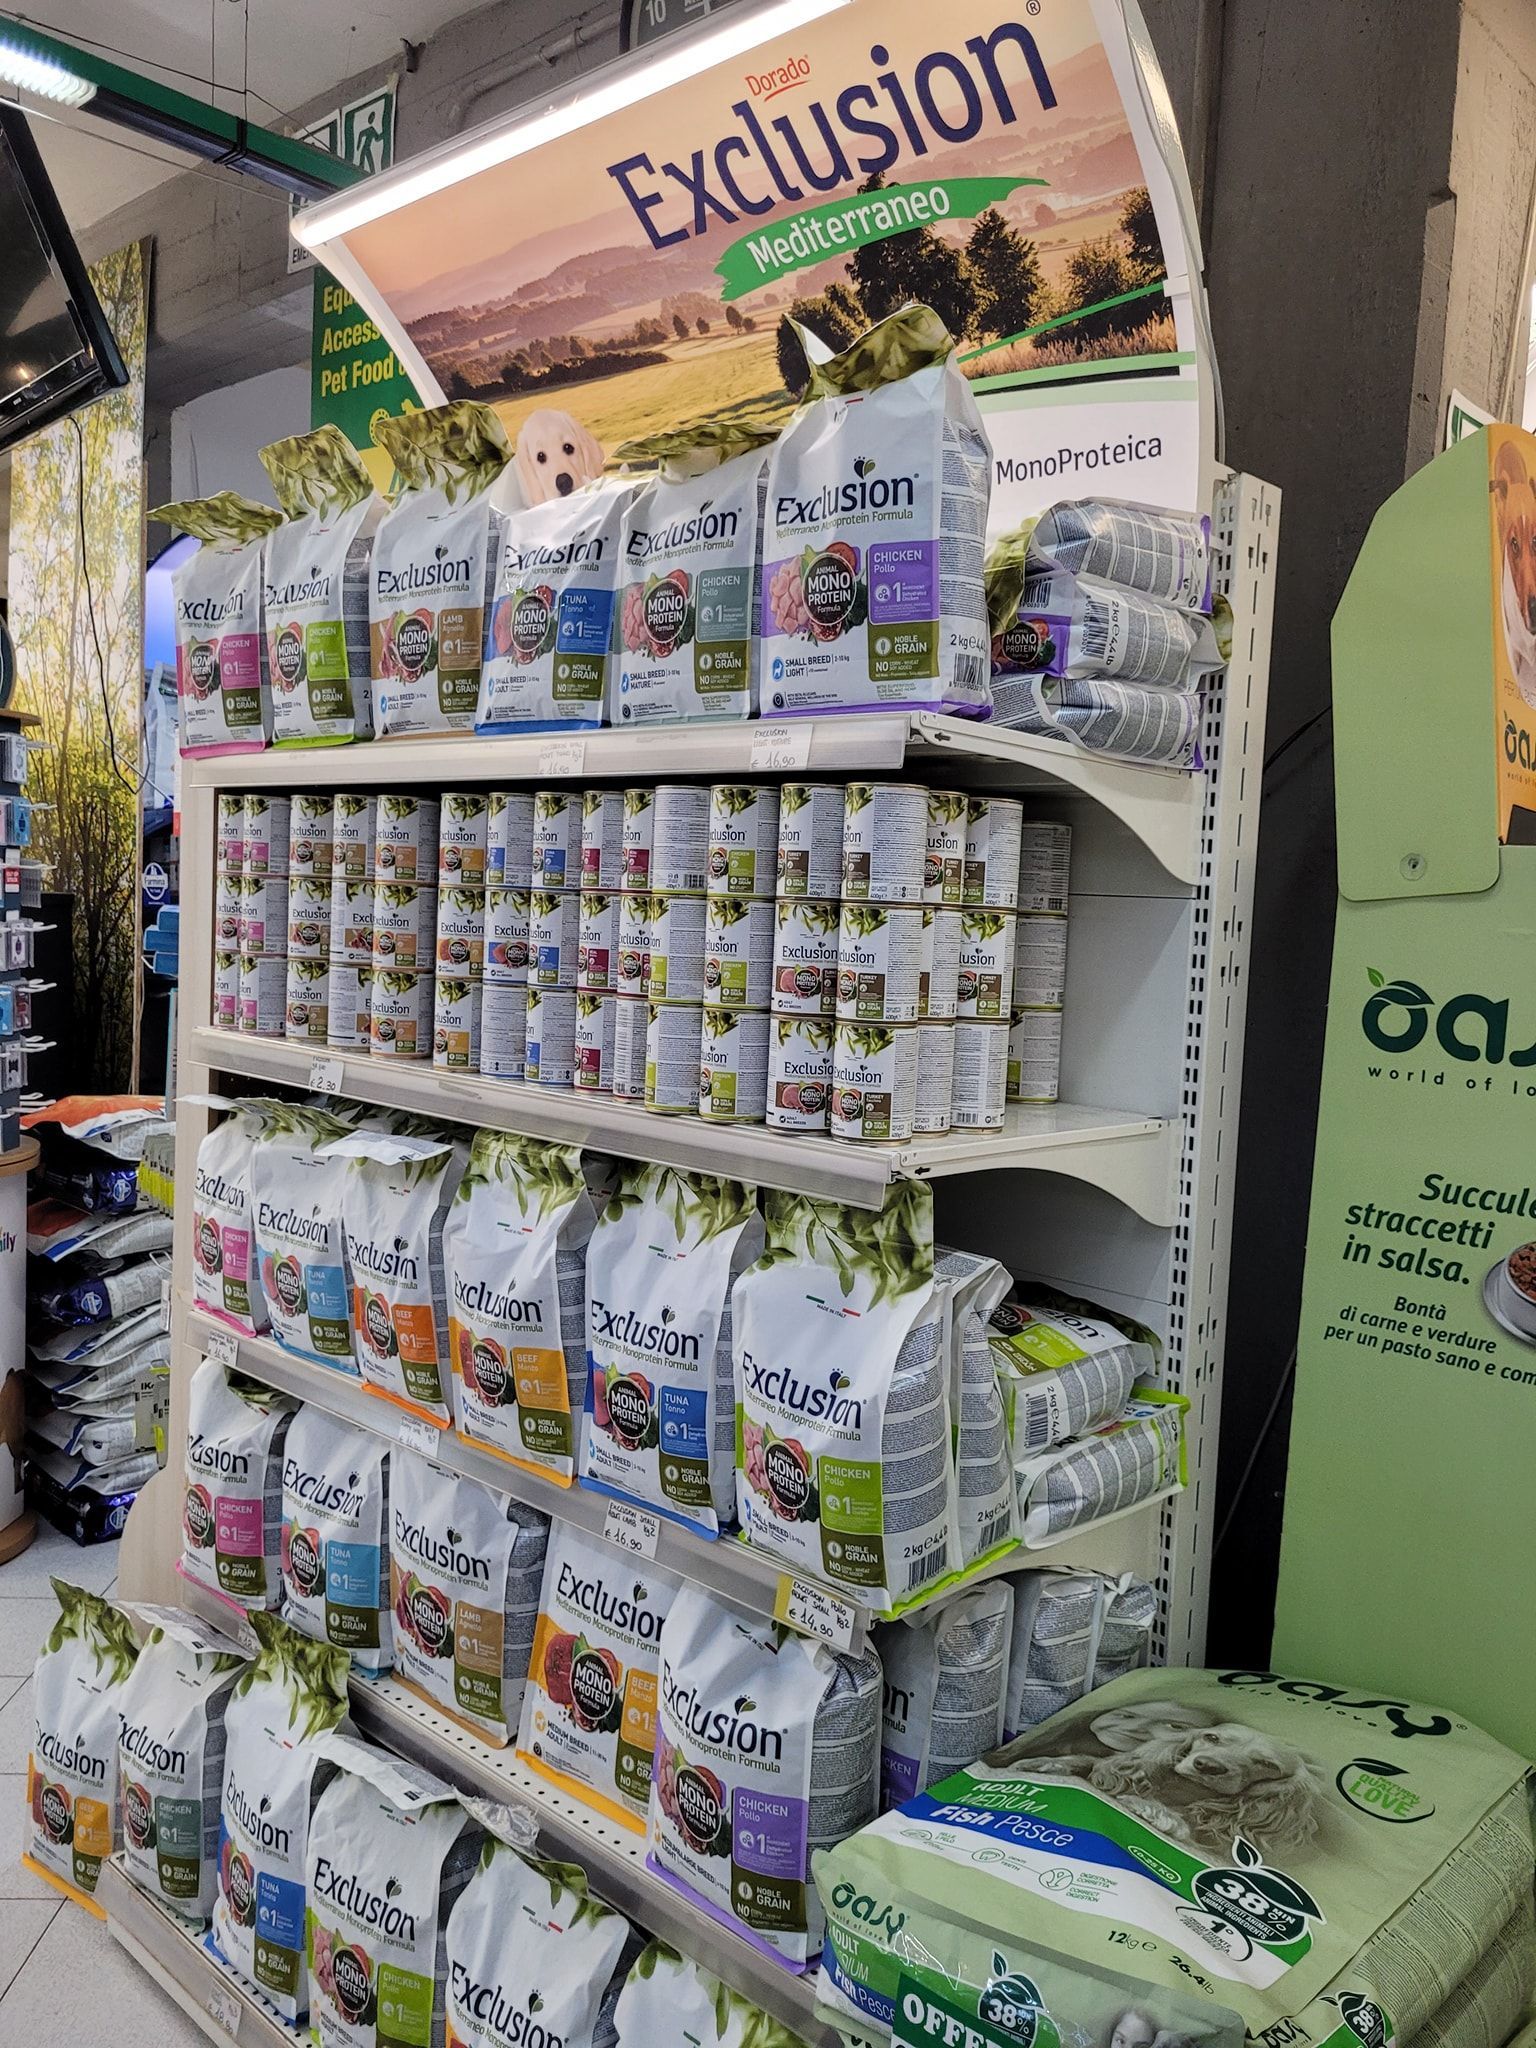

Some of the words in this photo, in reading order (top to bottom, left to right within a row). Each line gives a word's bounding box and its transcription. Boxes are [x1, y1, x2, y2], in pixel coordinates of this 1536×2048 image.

[743, 55, 811, 98] Dorado
[607, 22, 1058, 250] Exclusion
[746, 184, 950, 274] Mediterraneo
[323, 286, 357, 315] Equ
[321, 320, 380, 356] Access
[321, 364, 347, 397] Pet
[353, 352, 394, 389] Food
[996, 435, 1163, 485] MonoProteica
[775, 477, 914, 527] Exclusion
[872, 509, 913, 522] Formula
[627, 511, 737, 558] Exclusion
[703, 539, 735, 551] Formula
[874, 549, 922, 563] CHICKEN
[378, 559, 470, 594] Exclusion
[816, 565, 838, 575] ANIMAL
[874, 565, 896, 573] Pollo
[702, 575, 740, 587] CHICKEN
[808, 572, 850, 591] MONO
[565, 595, 587, 604] TUNA
[648, 595, 683, 612] MONO
[808, 589, 851, 606] PROTEIN
[443, 615, 463, 624] LAMB
[515, 609, 546, 624] MONO
[647, 611, 683, 626] PROTEIN
[400, 630, 428, 643] MONO
[514, 622, 546, 635] PROTEIN
[400, 643, 428, 655] PROTEIN
[894, 635, 918, 644] NOBLE
[894, 642, 927, 654] GRAIN
[1004, 644, 1038, 654] PROTEIN
[1005, 633, 1037, 646] MONO
[715, 657, 741, 669] GRAIN
[785, 659, 806, 668] SMALL
[808, 655, 831, 666] BREED
[875, 662, 889, 672] NO
[571, 670, 598, 679] GRAIN
[647, 669, 665, 680] BREED
[785, 668, 804, 678] LIGHT
[630, 681, 651, 690] MATURE
[441, 922, 484, 934] Exclusion
[782, 945, 838, 960] Exclusion
[784, 1061, 834, 1076] Exclusio
[1368, 1064, 1445, 1086] world
[1466, 1076, 1493, 1093] of
[1513, 1080, 1536, 1097] lo
[1419, 1173, 1536, 1220] Succule
[259, 1203, 328, 1244] Exclusion
[1345, 1202, 1496, 1250] straccetti
[1342, 1233, 1372, 1264] in
[1378, 1246, 1470, 1285] salsa.
[278, 1271, 298, 1287] MONO
[455, 1270, 542, 1323] Exclusion
[1394, 1295, 1447, 1322] Bontà
[511, 1322, 543, 1333] Formula
[591, 1299, 699, 1361] Exclusion
[1339, 1305, 1357, 1322] di
[1359, 1312, 1408, 1336] carne
[1412, 1322, 1423, 1336] e
[1428, 1325, 1497, 1355] verdure
[476, 1354, 500, 1374] MONO
[516, 1354, 538, 1364] BEEF
[622, 1344, 663, 1367] Monoprotein
[664, 1358, 698, 1372] Formula
[1324, 1325, 1352, 1345] per
[1356, 1331, 1378, 1349] un
[1381, 1337, 1431, 1361] pasto
[1436, 1349, 1480, 1373] sano
[1484, 1361, 1496, 1375] e
[1500, 1366, 1536, 1387] com
[476, 1367, 503, 1386] PROTEIN
[664, 1392, 690, 1406] TUNA
[742, 1350, 861, 1430] Exclusion
[611, 1390, 646, 1416] MONO
[664, 1403, 686, 1415] Tonno
[611, 1403, 646, 1426] PROTEIN
[777, 1406, 825, 1433] Monoprotein
[826, 1425, 861, 1441] Formula
[538, 1425, 563, 1436] GRAIN
[768, 1453, 804, 1485] MONO
[824, 1464, 871, 1480] CHICKEN
[283, 1458, 363, 1518] Exclusion
[681, 1473, 709, 1485] GRAIN
[768, 1469, 805, 1497] PROTEIN
[824, 1475, 844, 1487] Pollo
[220, 1503, 253, 1514] CHICKEN
[293, 1542, 316, 1566] MONO
[331, 1547, 351, 1558] TUNA
[396, 1510, 489, 1581] Exclusion
[845, 1543, 869, 1554] NOBLE
[845, 1551, 878, 1564] GRAIN
[231, 1568, 256, 1578] GRAIN
[414, 1599, 443, 1626] MONO
[460, 1608, 481, 1621] LAMB
[342, 1620, 367, 1631] GRAIN
[415, 1613, 443, 1637] PROTEIN
[592, 1617, 635, 1648] Monoprotein
[576, 1662, 611, 1695] MONO
[574, 1680, 610, 1707] PROTEIN
[663, 1658, 781, 1761] Exclusion
[546, 1731, 563, 1748] ADULT
[568, 1733, 590, 1753] BREED
[685, 1728, 736, 1763] Monoprotein
[738, 1753, 780, 1774] Formula
[678, 1776, 716, 1816] MONO
[972, 1781, 1046, 1798] ADULT
[1349, 1779, 1411, 1818] LOVE
[160, 1802, 192, 1814] CHICKEN
[679, 1795, 716, 1829] PROTEIN
[739, 1796, 788, 1818] CHICKEN
[956, 1792, 1048, 1814] MEDIUM
[739, 1807, 760, 1822] Pollo
[929, 1805, 995, 1826] Fish
[994, 1814, 1074, 1848] Pesce
[174, 1871, 197, 1881] GRAIN
[261, 1879, 280, 1894] TUNA
[757, 1885, 781, 1899] NOBLE
[314, 1857, 416, 1941] Exclusion
[756, 1893, 790, 1910] GRAIN
[1214, 1878, 1270, 1916] 38
[832, 1882, 905, 1944] oasy
[1204, 1890, 1246, 1919] INGREDIENTI
[1246, 1914, 1274, 1937] ANIMALI
[1267, 1911, 1287, 1931] %
[1272, 1907, 1296, 1925] MIN
[1224, 1910, 1267, 1940] INGREDIENTS
[383, 1936, 415, 1953] Formula
[336, 1958, 366, 1989] MONO
[384, 1971, 421, 1990] CHICKEN
[835, 1964, 857, 2001] Fish
[1169, 1955, 1215, 1995] 26.4lb
[335, 1973, 366, 2000] PROTEIN
[452, 1960, 562, 2048] Exclusion
[988, 1999, 1017, 2029] 38
